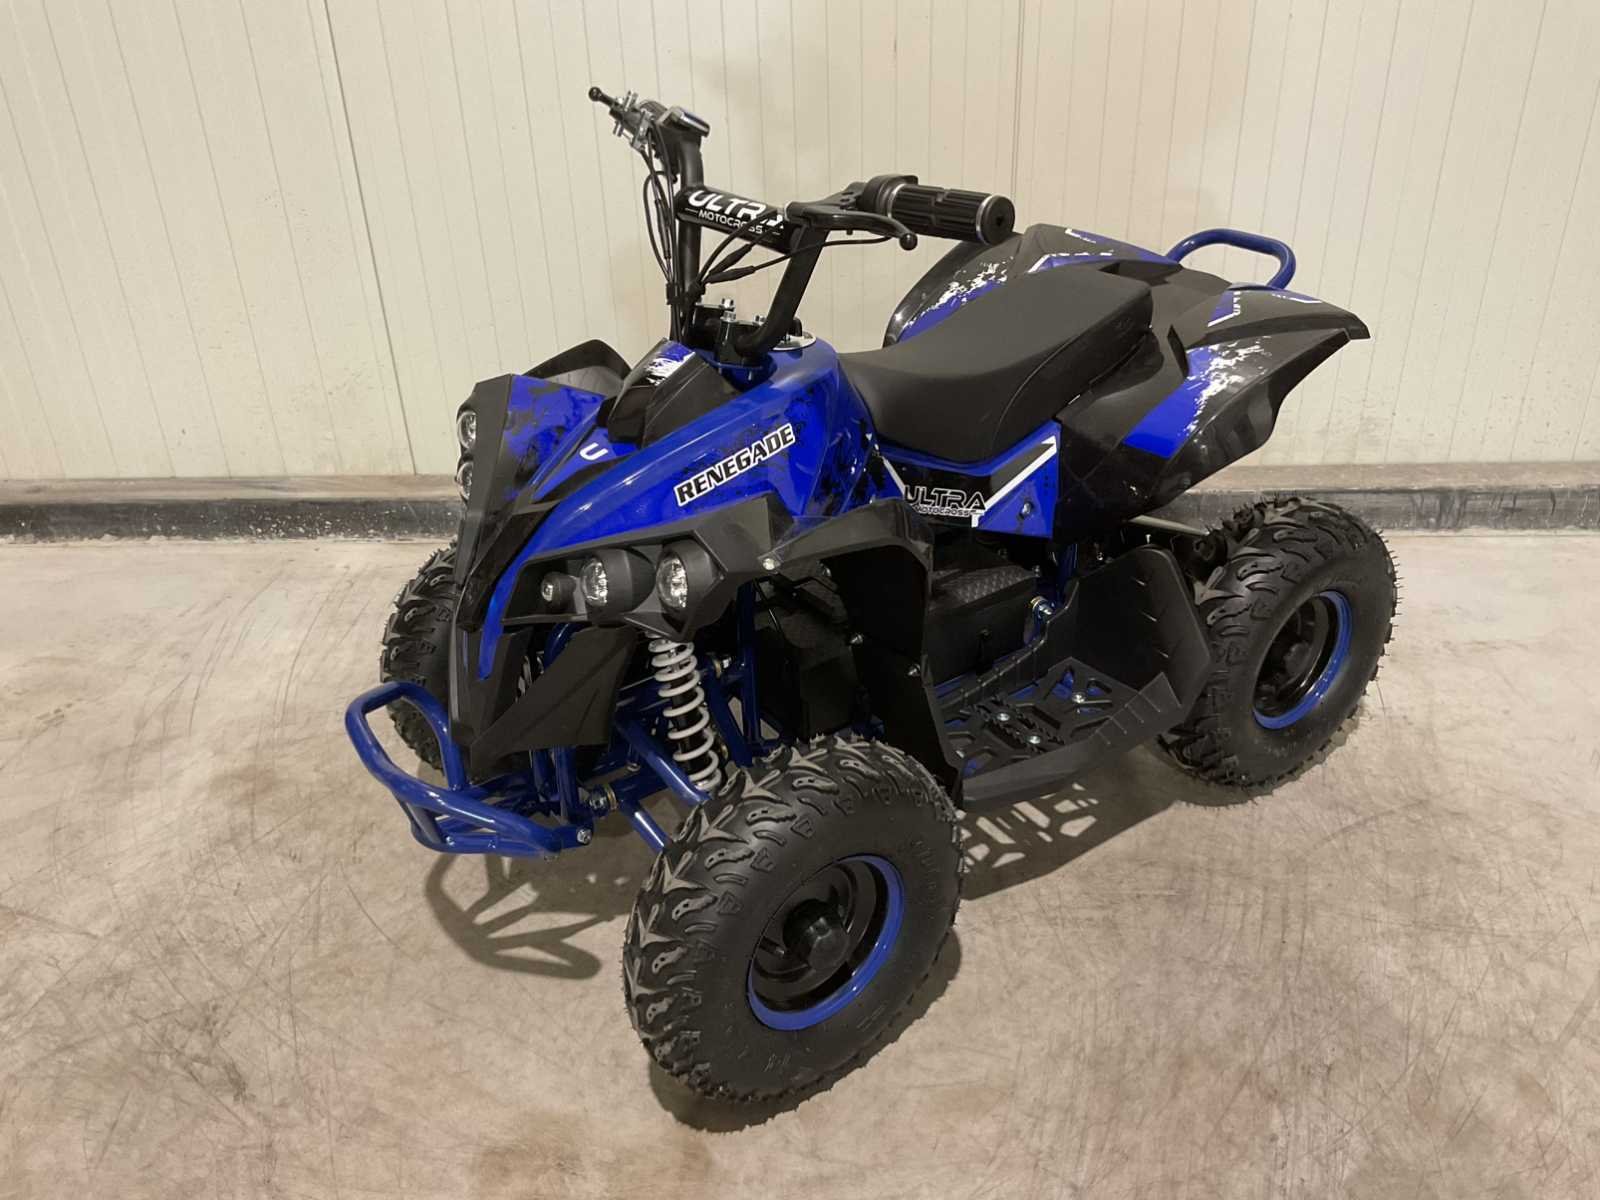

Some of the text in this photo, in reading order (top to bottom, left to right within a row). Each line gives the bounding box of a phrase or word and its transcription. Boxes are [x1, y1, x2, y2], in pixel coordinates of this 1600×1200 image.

[580, 442, 608, 461] U
[674, 423, 795, 506] RENEGADE
[903, 485, 986, 511] ULTRA
